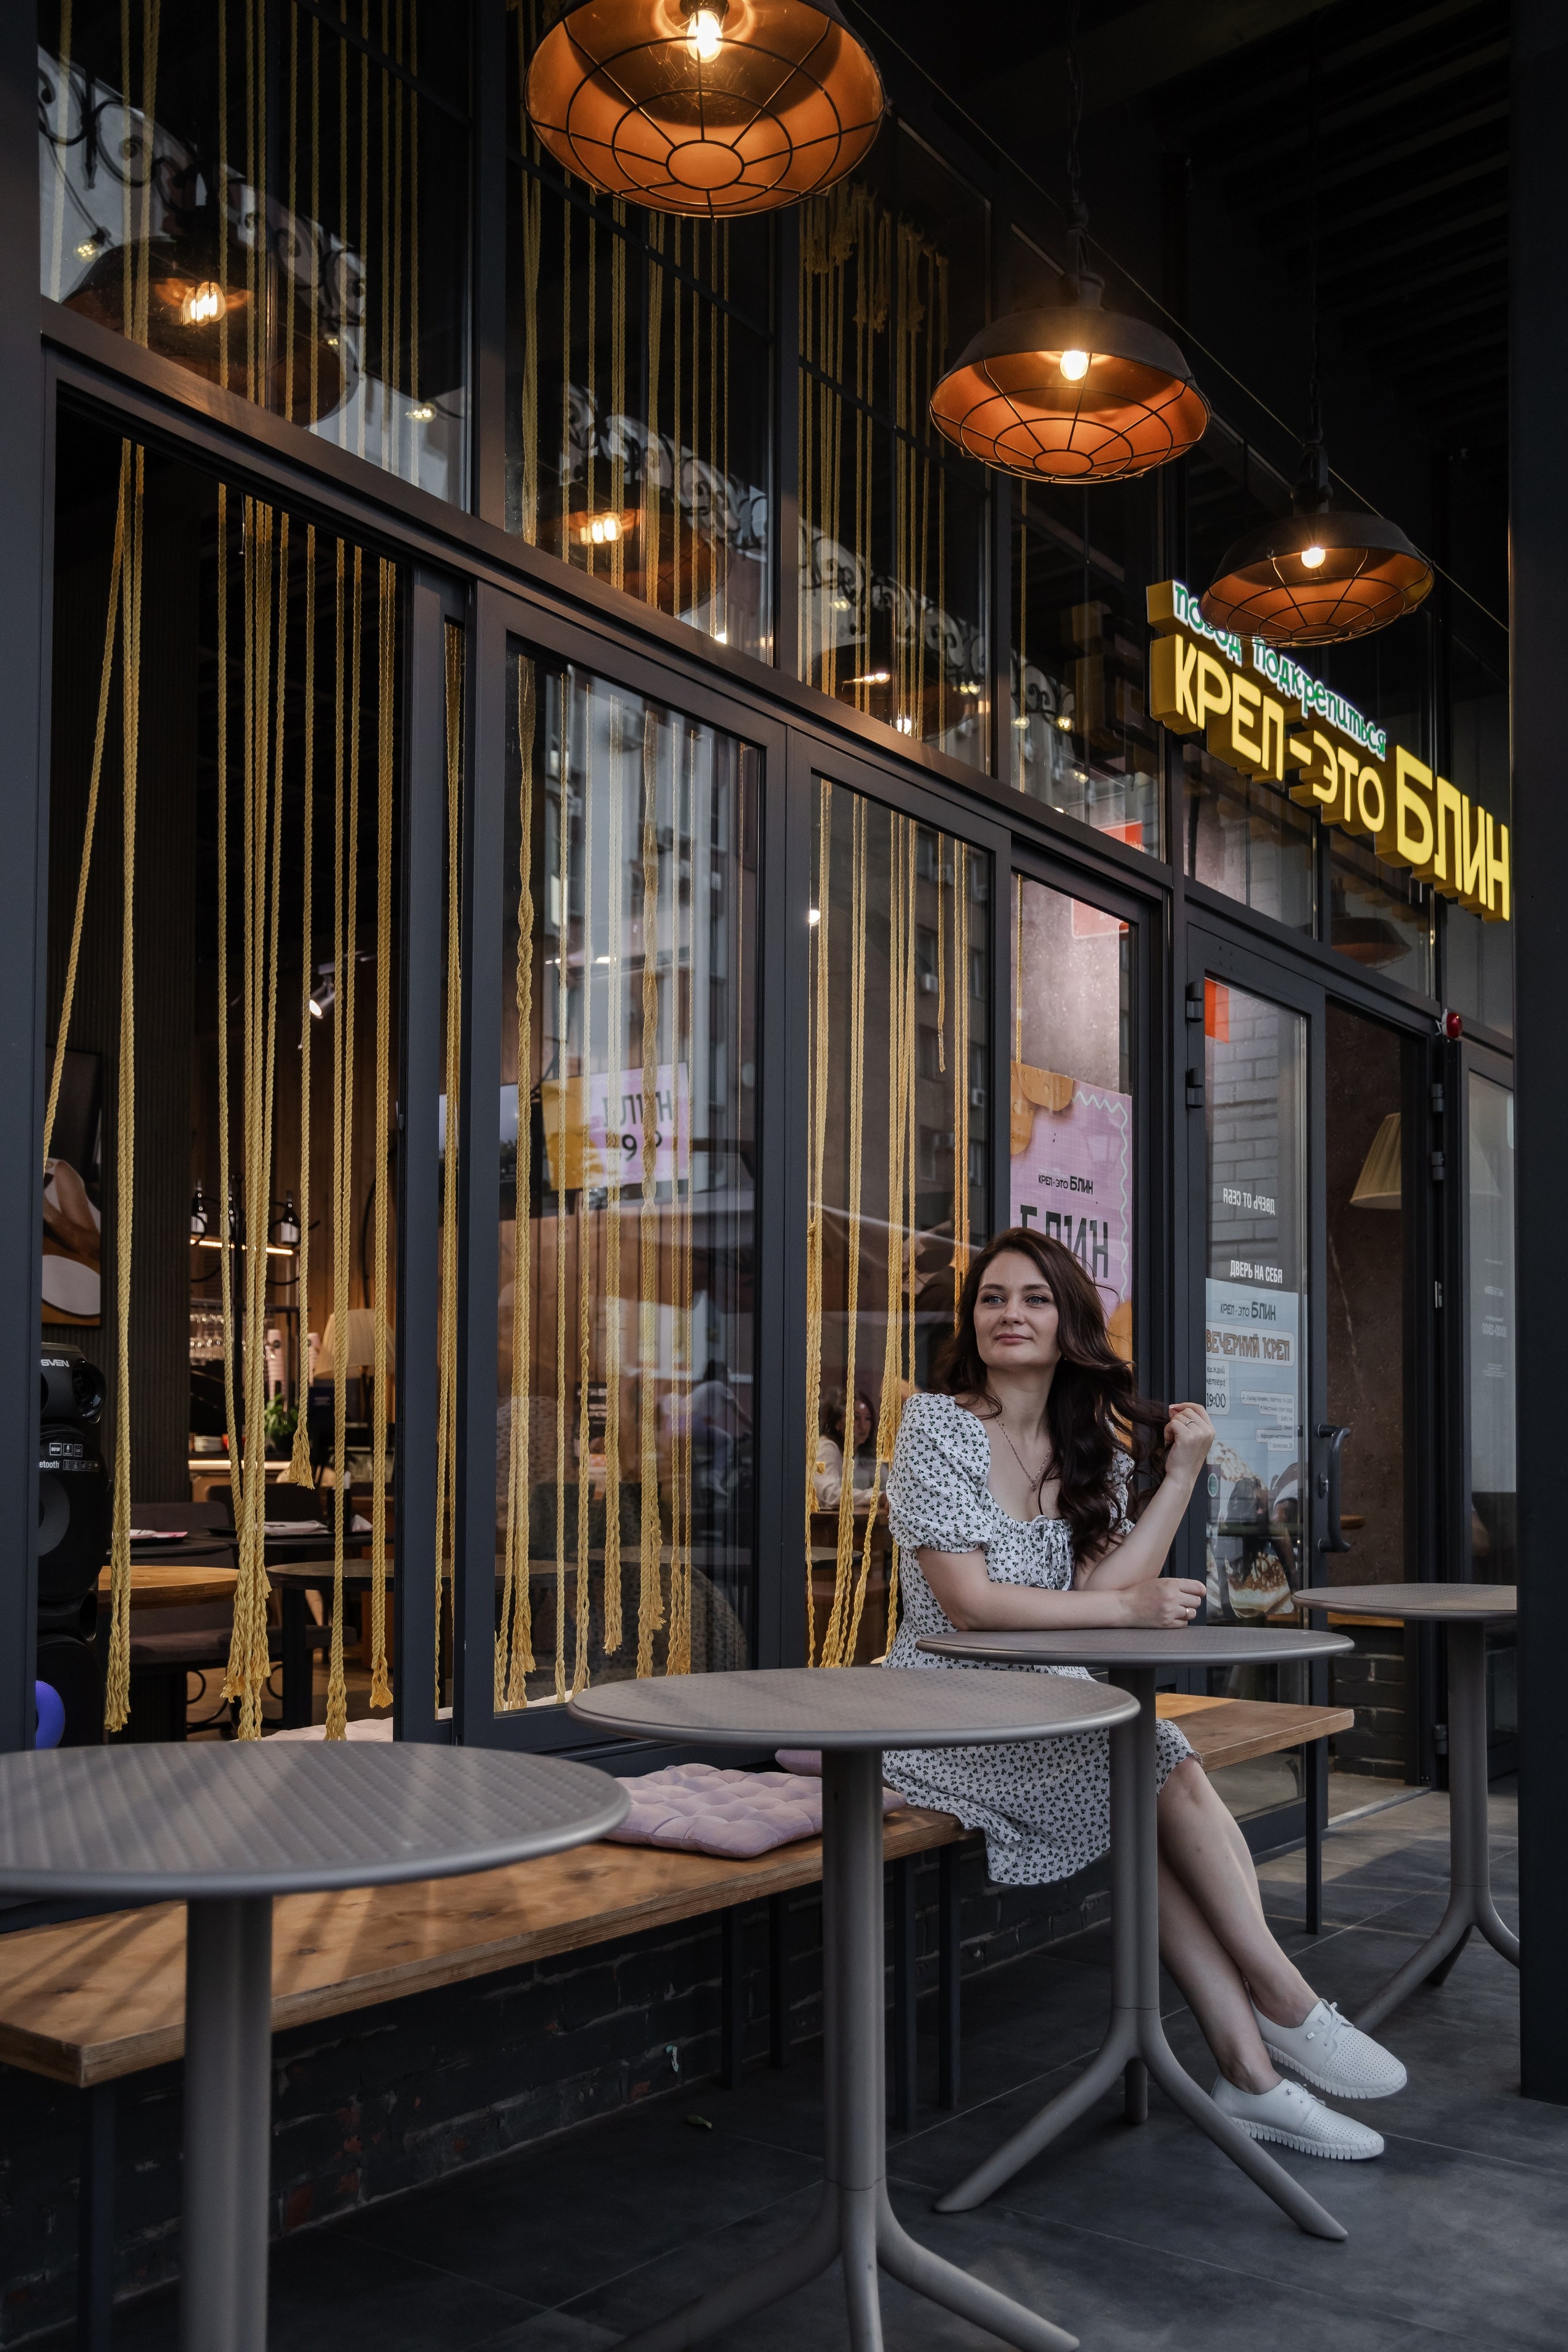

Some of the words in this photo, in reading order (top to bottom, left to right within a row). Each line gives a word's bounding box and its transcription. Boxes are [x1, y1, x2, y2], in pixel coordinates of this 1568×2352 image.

[1396, 745, 1510, 921] БЛИН
[1070, 1175, 1093, 1195] БЛИН
[1230, 1259, 1253, 1279] ДВЕРЬ
[1254, 1264, 1264, 1281] НА
[1265, 1265, 1283, 1284] СЕБЯ
[1251, 1301, 1276, 1321] БЛИН
[1206, 1329, 1260, 1358] ВЕЧЕРНИЙ
[1262, 1337, 1291, 1361] КРЕП
[40, 1359, 70, 1367] SVEN
[1206, 1392, 1226, 1408] 19:00
